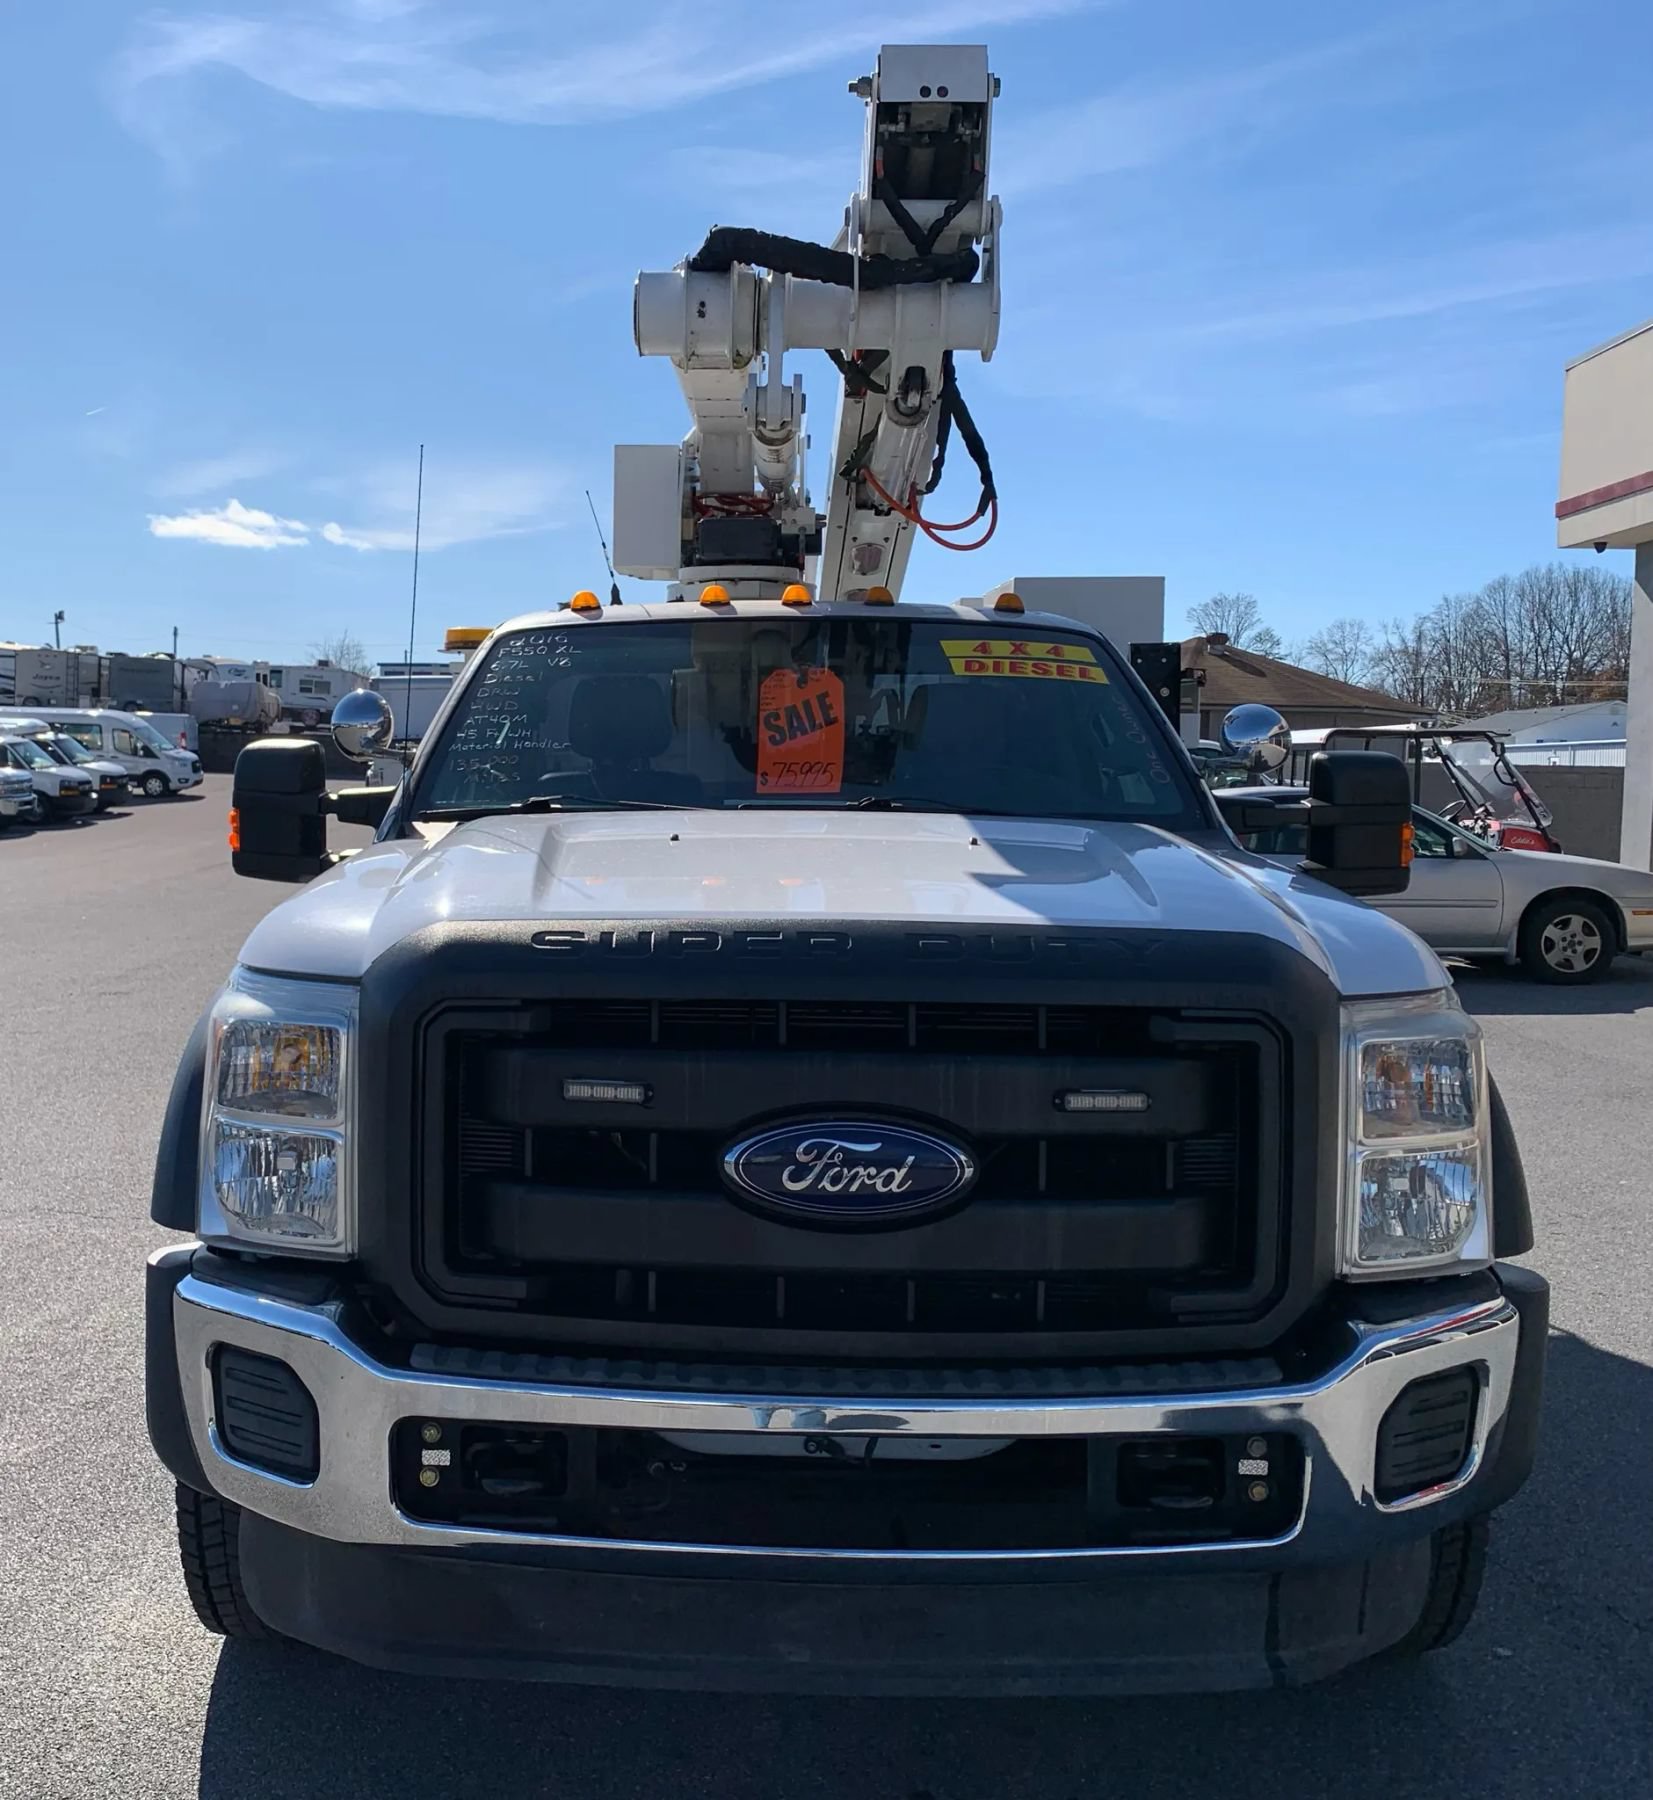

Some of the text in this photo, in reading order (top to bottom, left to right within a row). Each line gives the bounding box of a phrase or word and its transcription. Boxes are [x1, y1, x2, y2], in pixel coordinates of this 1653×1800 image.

[498, 644, 582, 658] F550 XL
[490, 660, 529, 671] 6.7L
[963, 659, 1097, 682] DIESEL
[483, 671, 544, 684] Diesel
[477, 686, 521, 698] DRW
[470, 700, 519, 711] 4WD
[763, 690, 839, 747] SALE
[456, 728, 478, 740] 45
[449, 740, 572, 752] Material Handler
[772, 760, 837, 785] 75995
[530, 930, 1165, 967] SUPER DUTY
[781, 1138, 916, 1193] Ford
